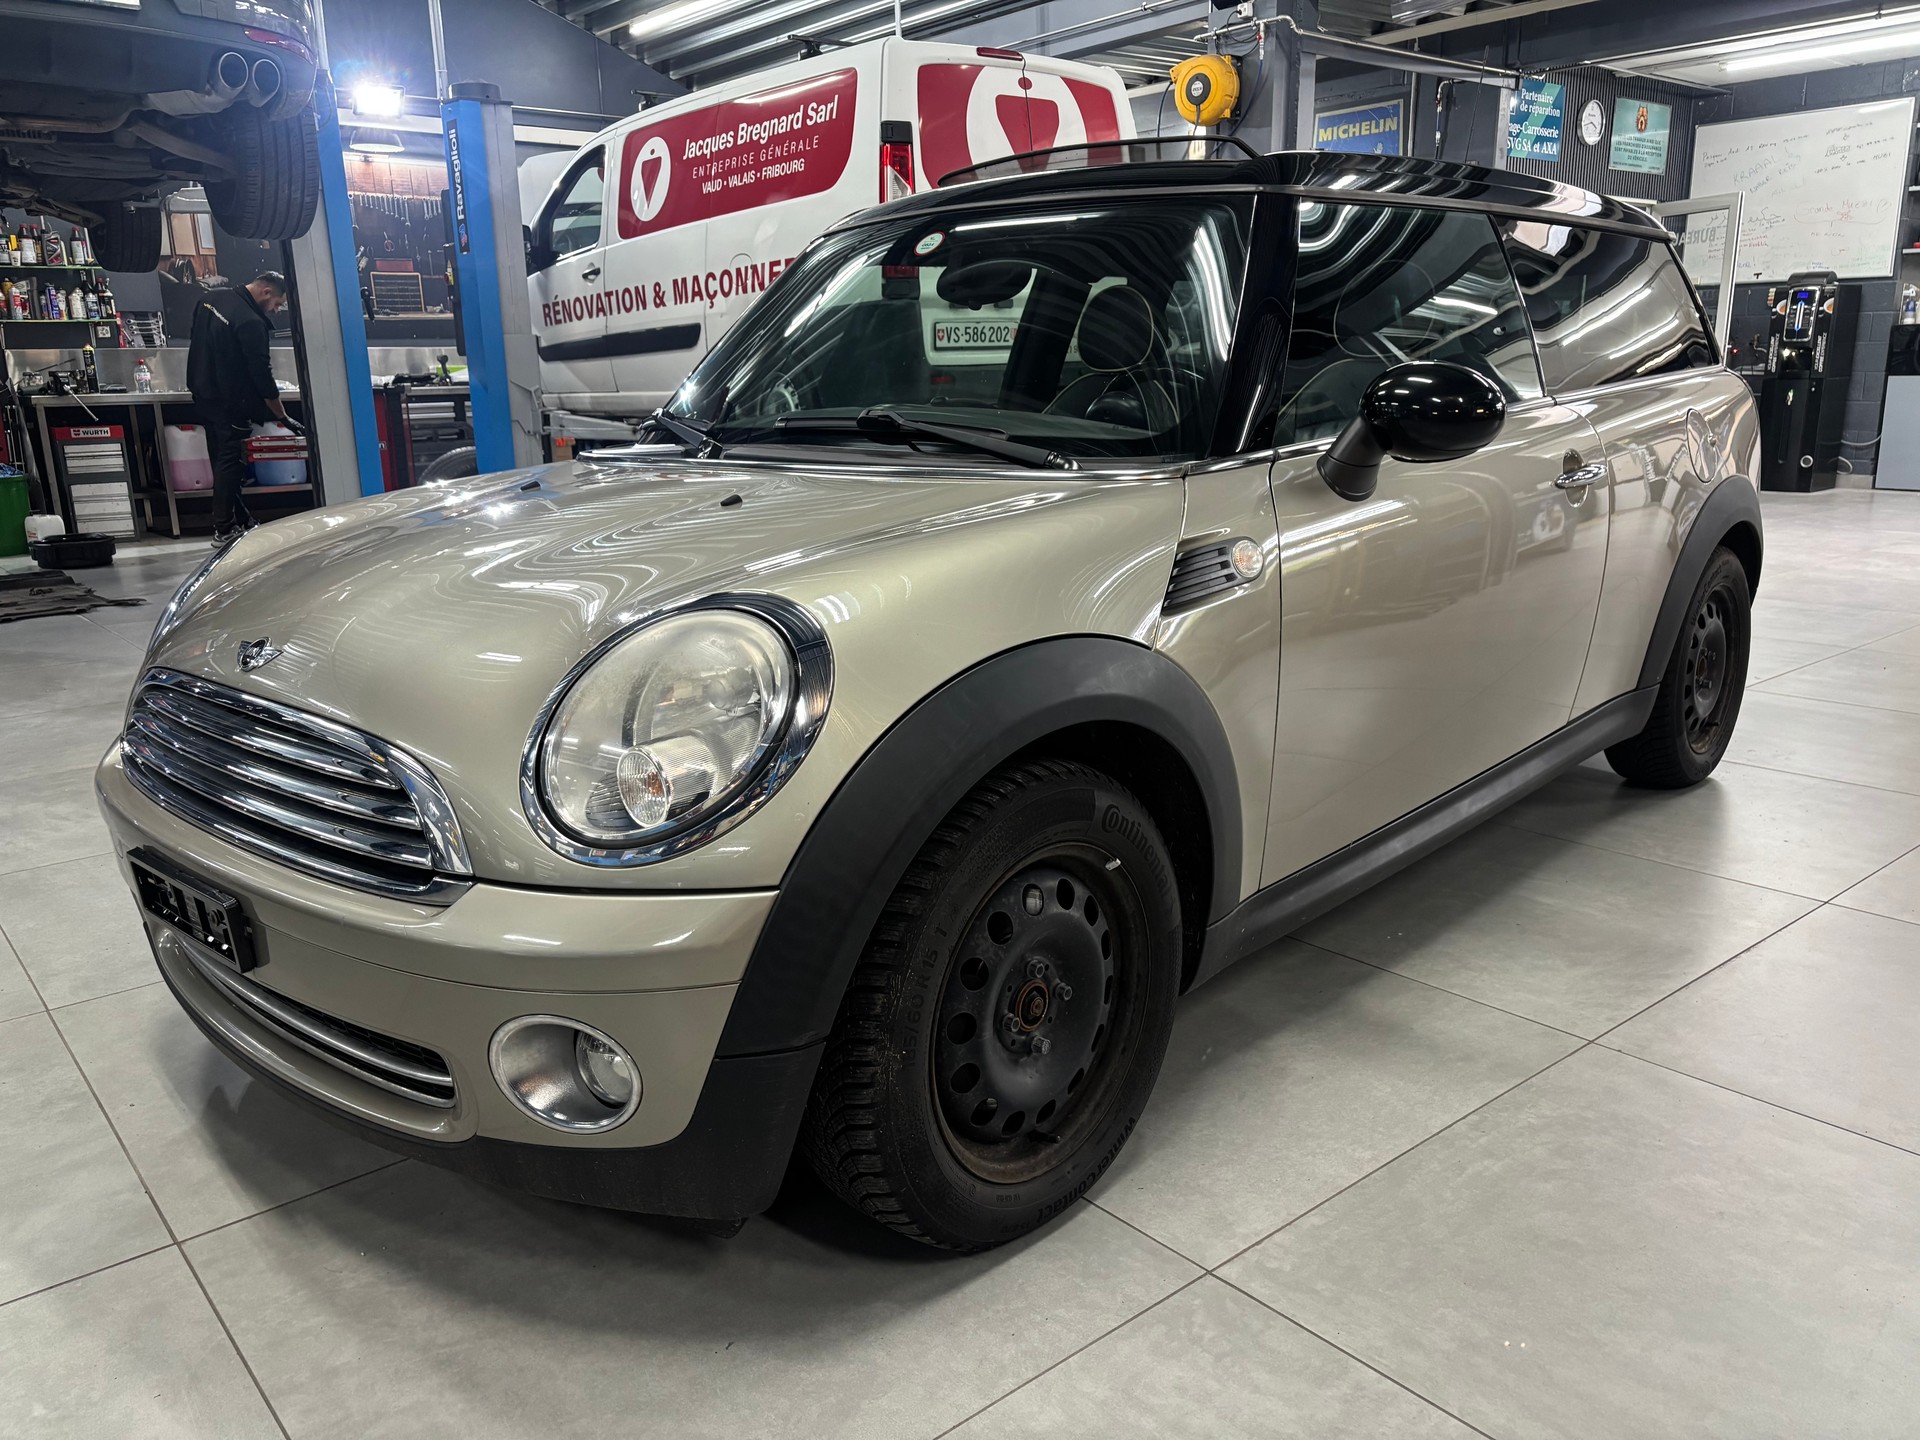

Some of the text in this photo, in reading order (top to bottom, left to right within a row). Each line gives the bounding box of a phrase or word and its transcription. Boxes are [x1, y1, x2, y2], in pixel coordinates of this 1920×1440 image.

[1519, 100, 1561, 118] de réparation
[1521, 88, 1554, 104] Partenaire
[682, 94, 839, 160] Jacques Bregnard Sarl
[1318, 117, 1398, 142] MICHELIN
[1508, 121, 1559, 138] age-Carrosserie
[692, 135, 820, 179] ENTREPRISE GÉNÉRALE
[1533, 142, 1540, 153] et
[1541, 142, 1557, 155] AXA
[448, 128, 465, 221] Ravaglioli
[702, 158, 805, 195] VAUD VALAIS FRIBOURG
[542, 284, 647, 327] RÉNOVATION
[652, 281, 667, 309] &
[1101, 803, 1171, 899] Continental
